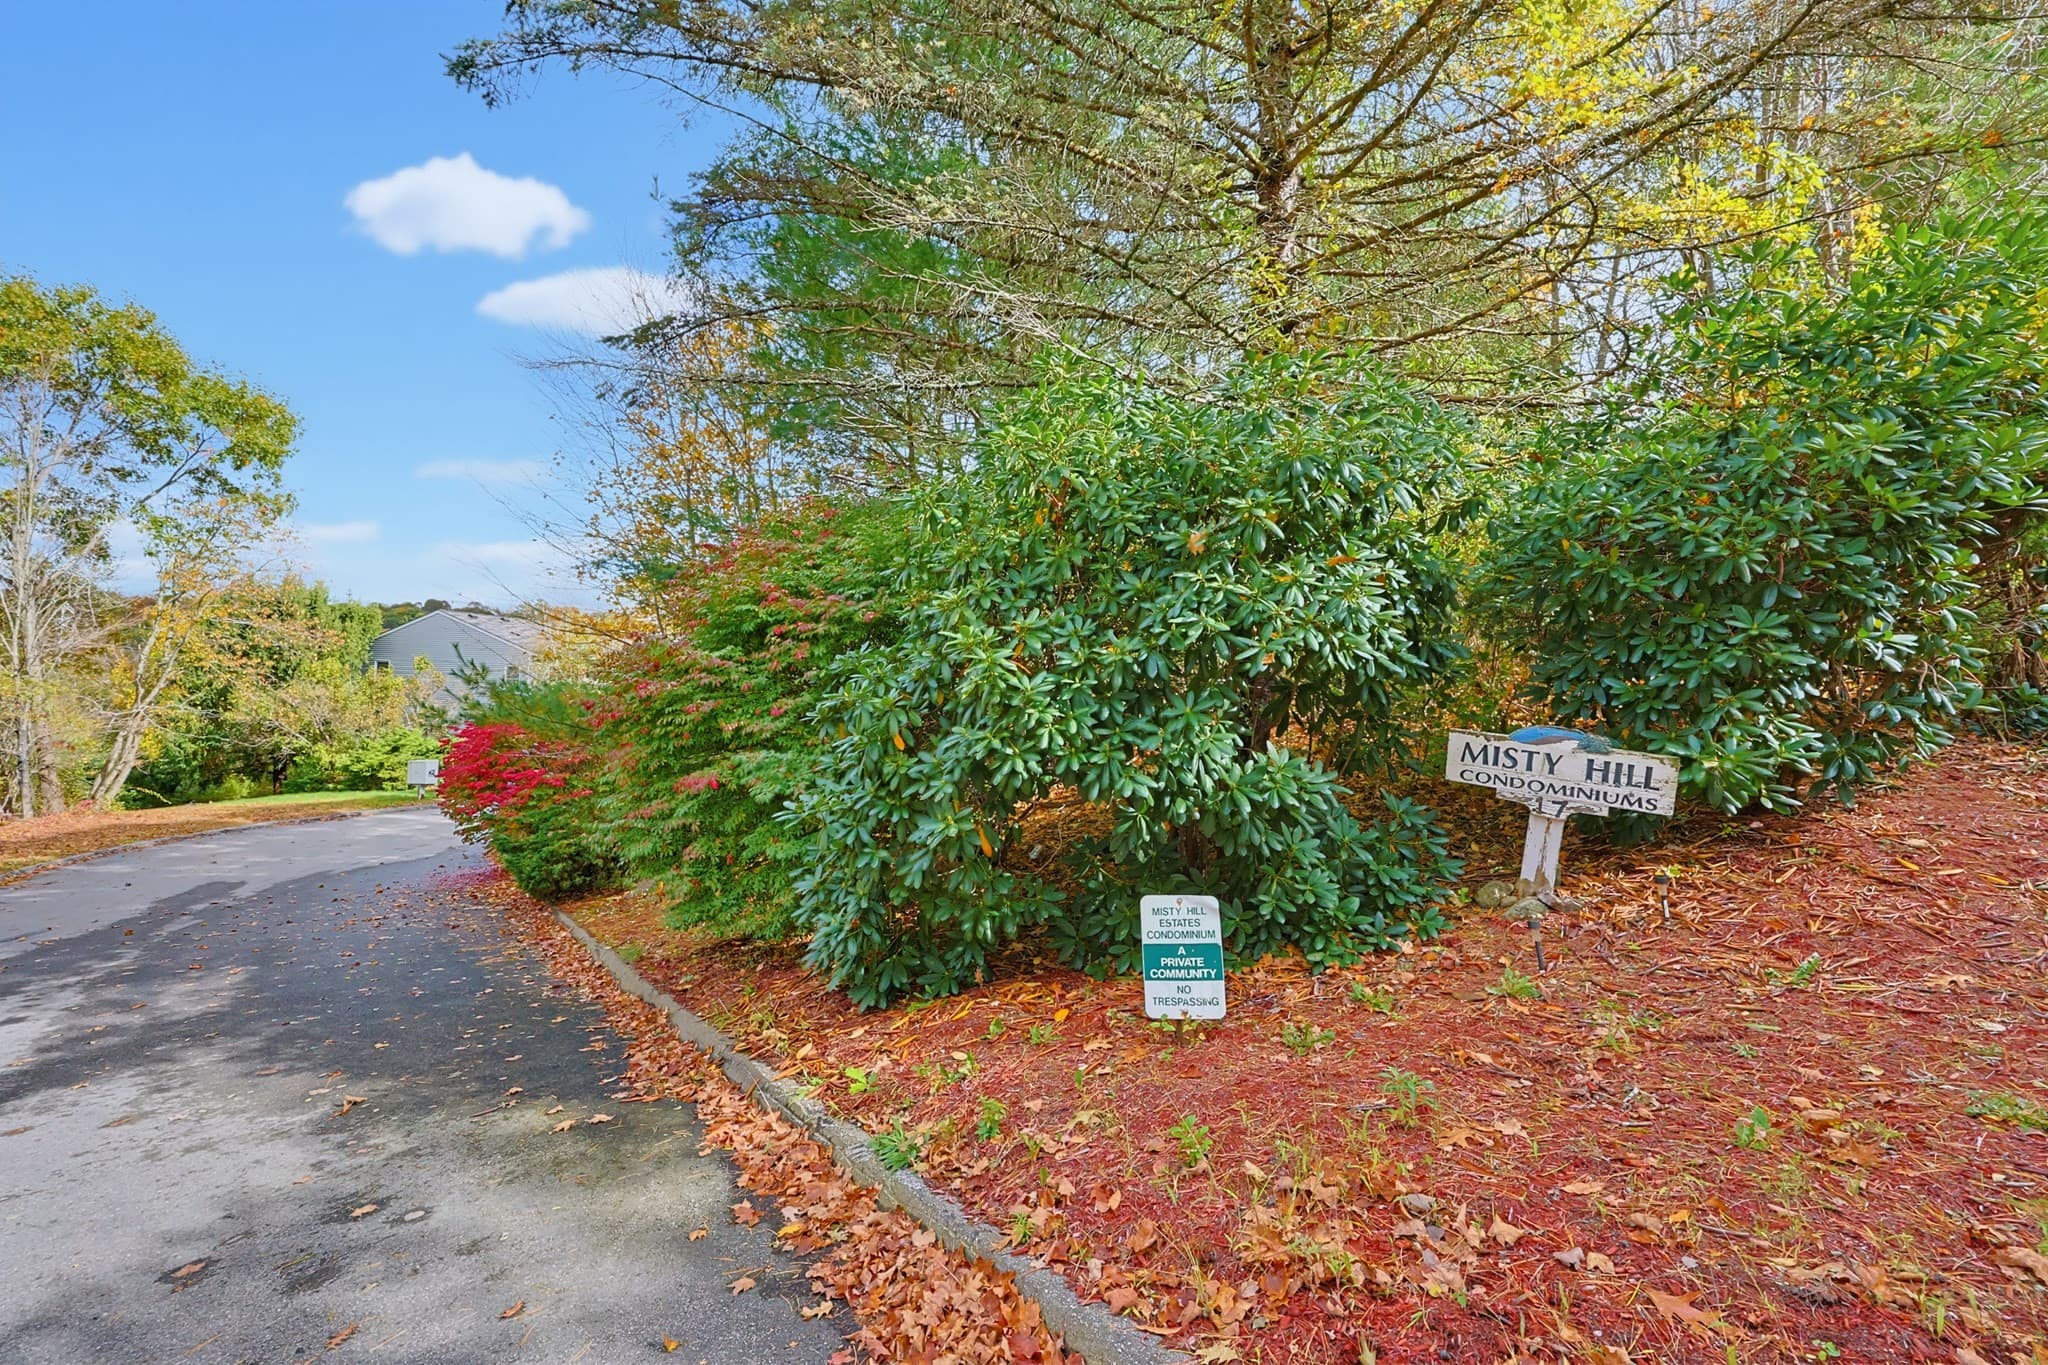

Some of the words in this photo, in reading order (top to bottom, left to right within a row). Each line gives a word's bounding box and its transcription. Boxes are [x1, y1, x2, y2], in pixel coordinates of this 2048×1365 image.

[1460, 742, 1564, 775] MISTY
[1585, 758, 1660, 792] HILL
[1459, 769, 1659, 812] CONDOMINIUMS
[1152, 907, 1181, 916] MISTY
[1186, 907, 1206, 916] HILL
[1160, 919, 1200, 928] ESTATES
[1147, 930, 1216, 939] CONDOMINIUM
[1177, 946, 1186, 955] A
[1160, 957, 1204, 967] PRIVATE
[1149, 969, 1217, 979] COMMUNITY
[1177, 985, 1191, 994] NO
[1153, 997, 1219, 1006] TRESPASSING
